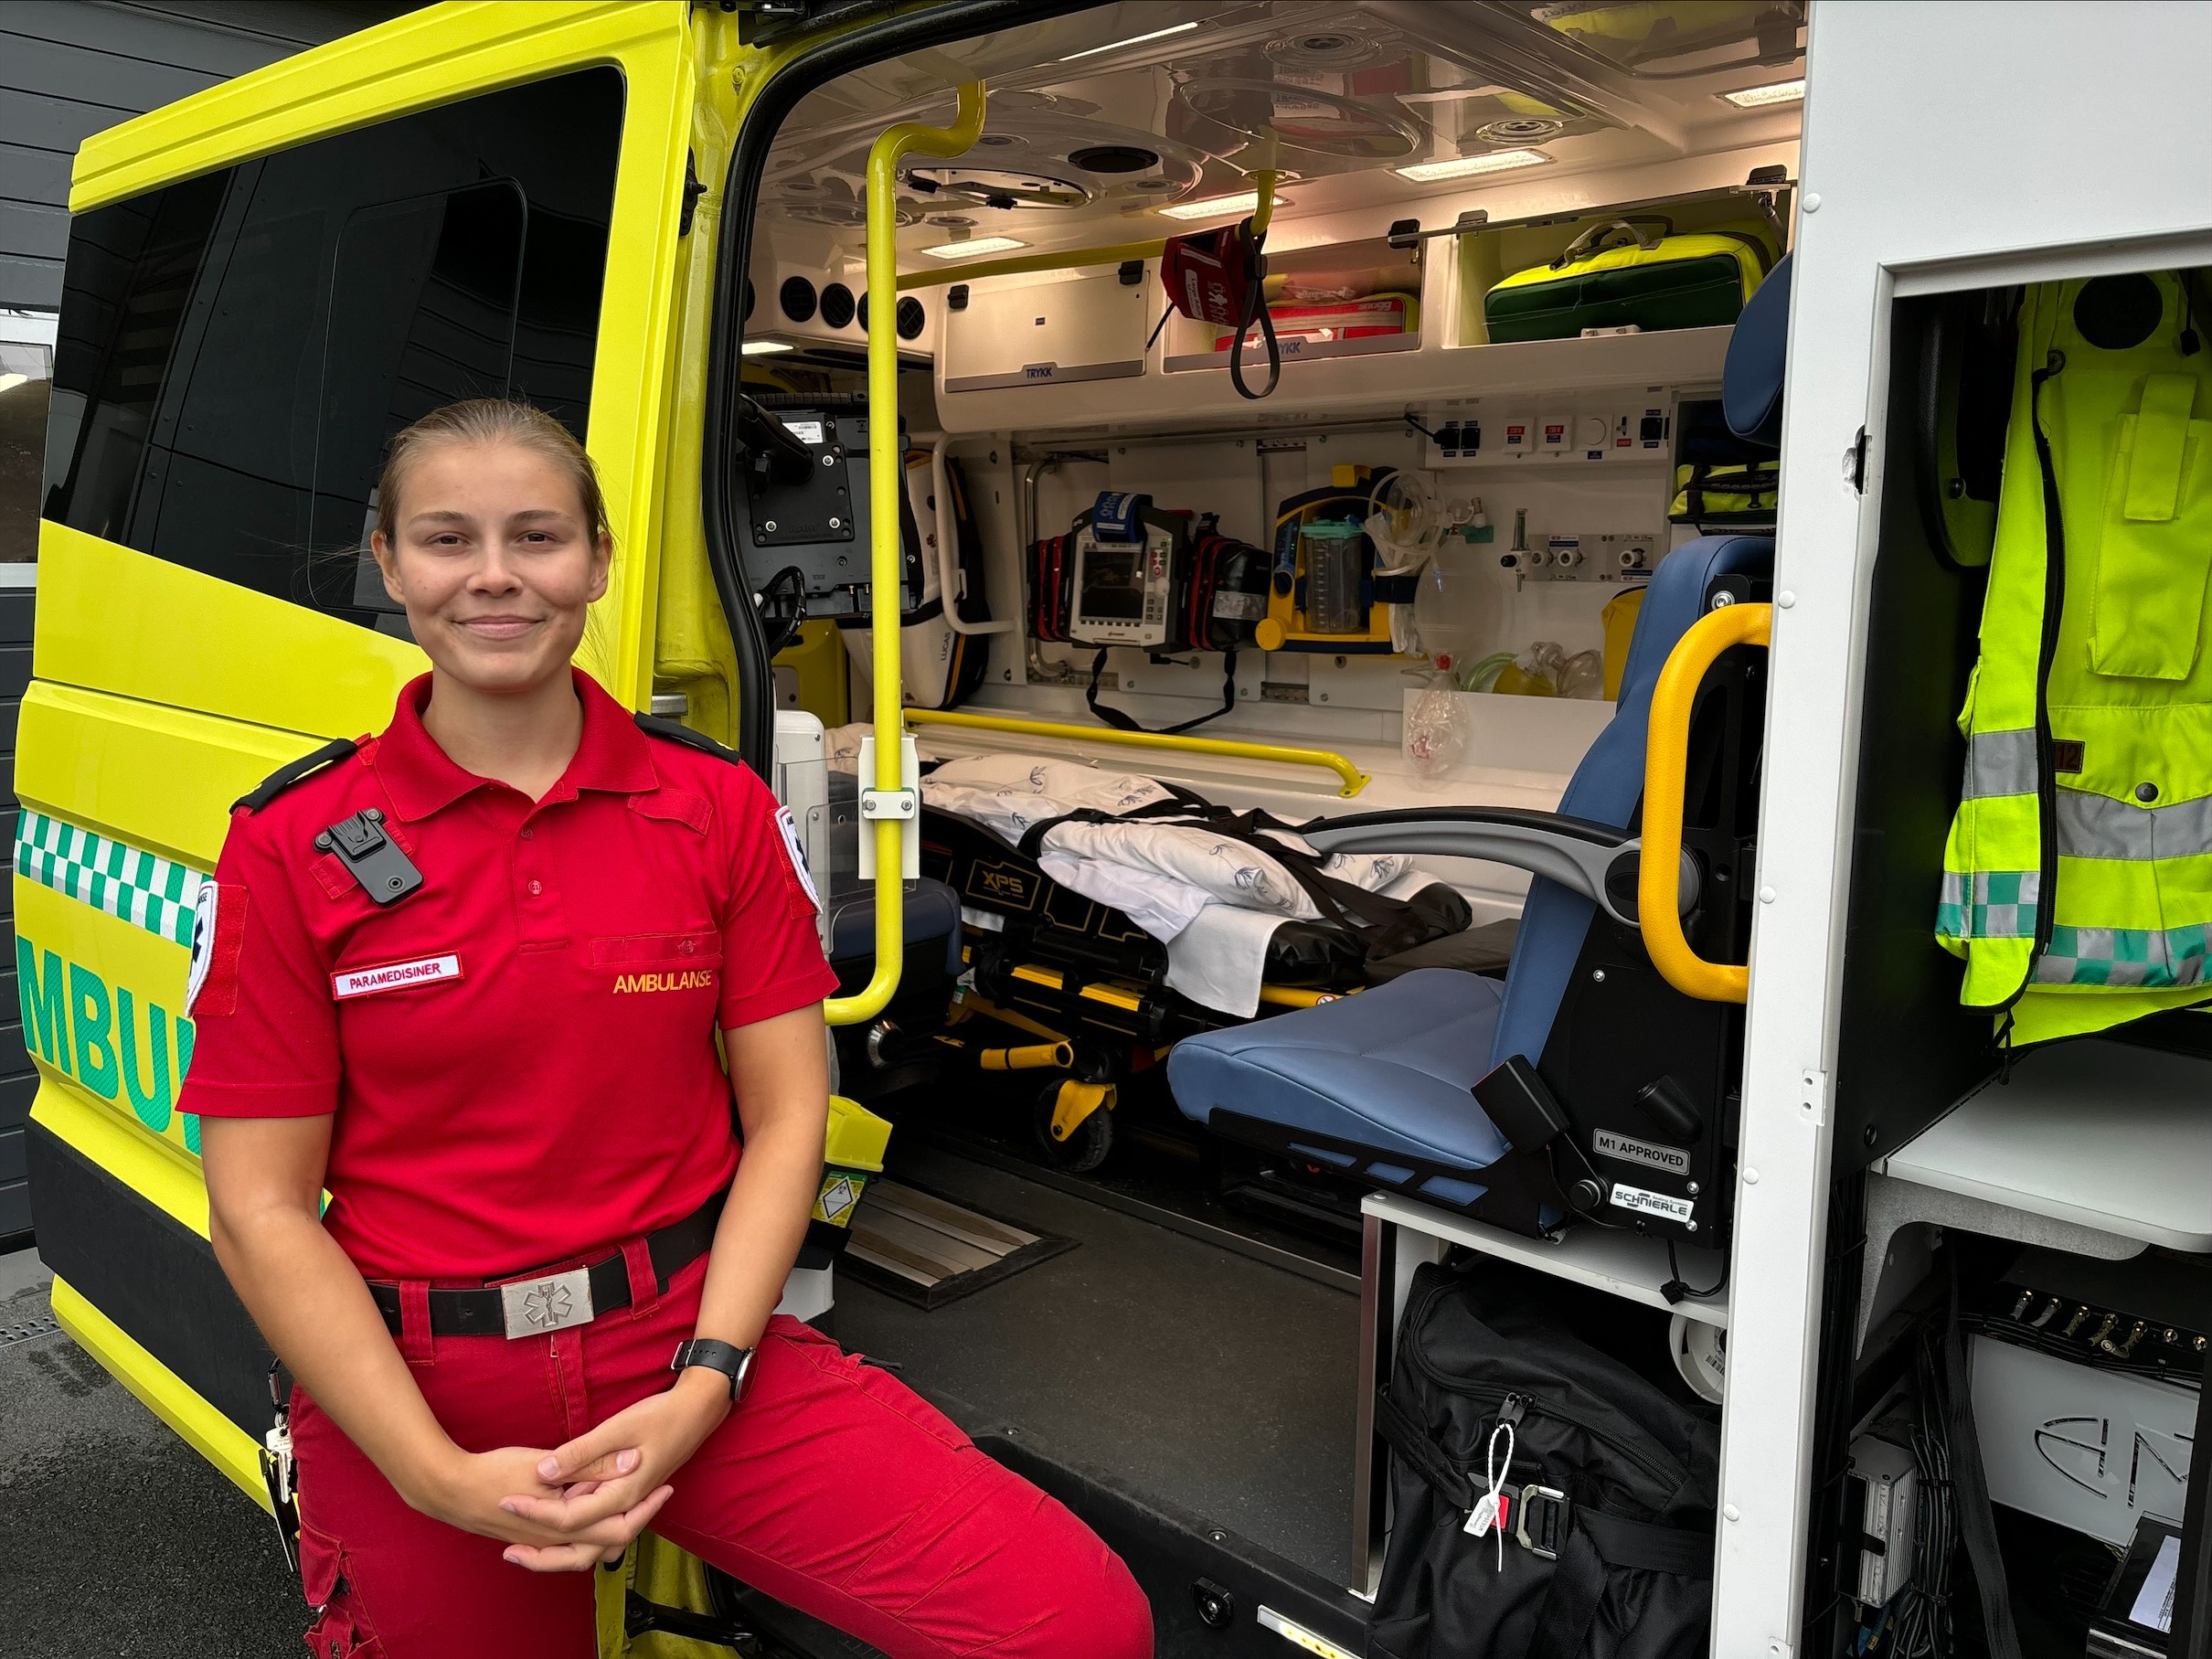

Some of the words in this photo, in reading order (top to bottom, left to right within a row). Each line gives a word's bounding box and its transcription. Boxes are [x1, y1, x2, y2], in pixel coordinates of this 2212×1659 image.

[1026, 367, 1052, 378] TRYKK
[941, 632, 951, 662] LUCAS
[982, 870, 1024, 894] XPS
[349, 962, 441, 989] PARAMEDISINER
[612, 970, 712, 994] AMBULANSE
[1600, 1137, 1616, 1150] M1
[1619, 1143, 1684, 1166] APPROVED
[1615, 1191, 1687, 1216] SCHNIERLE
